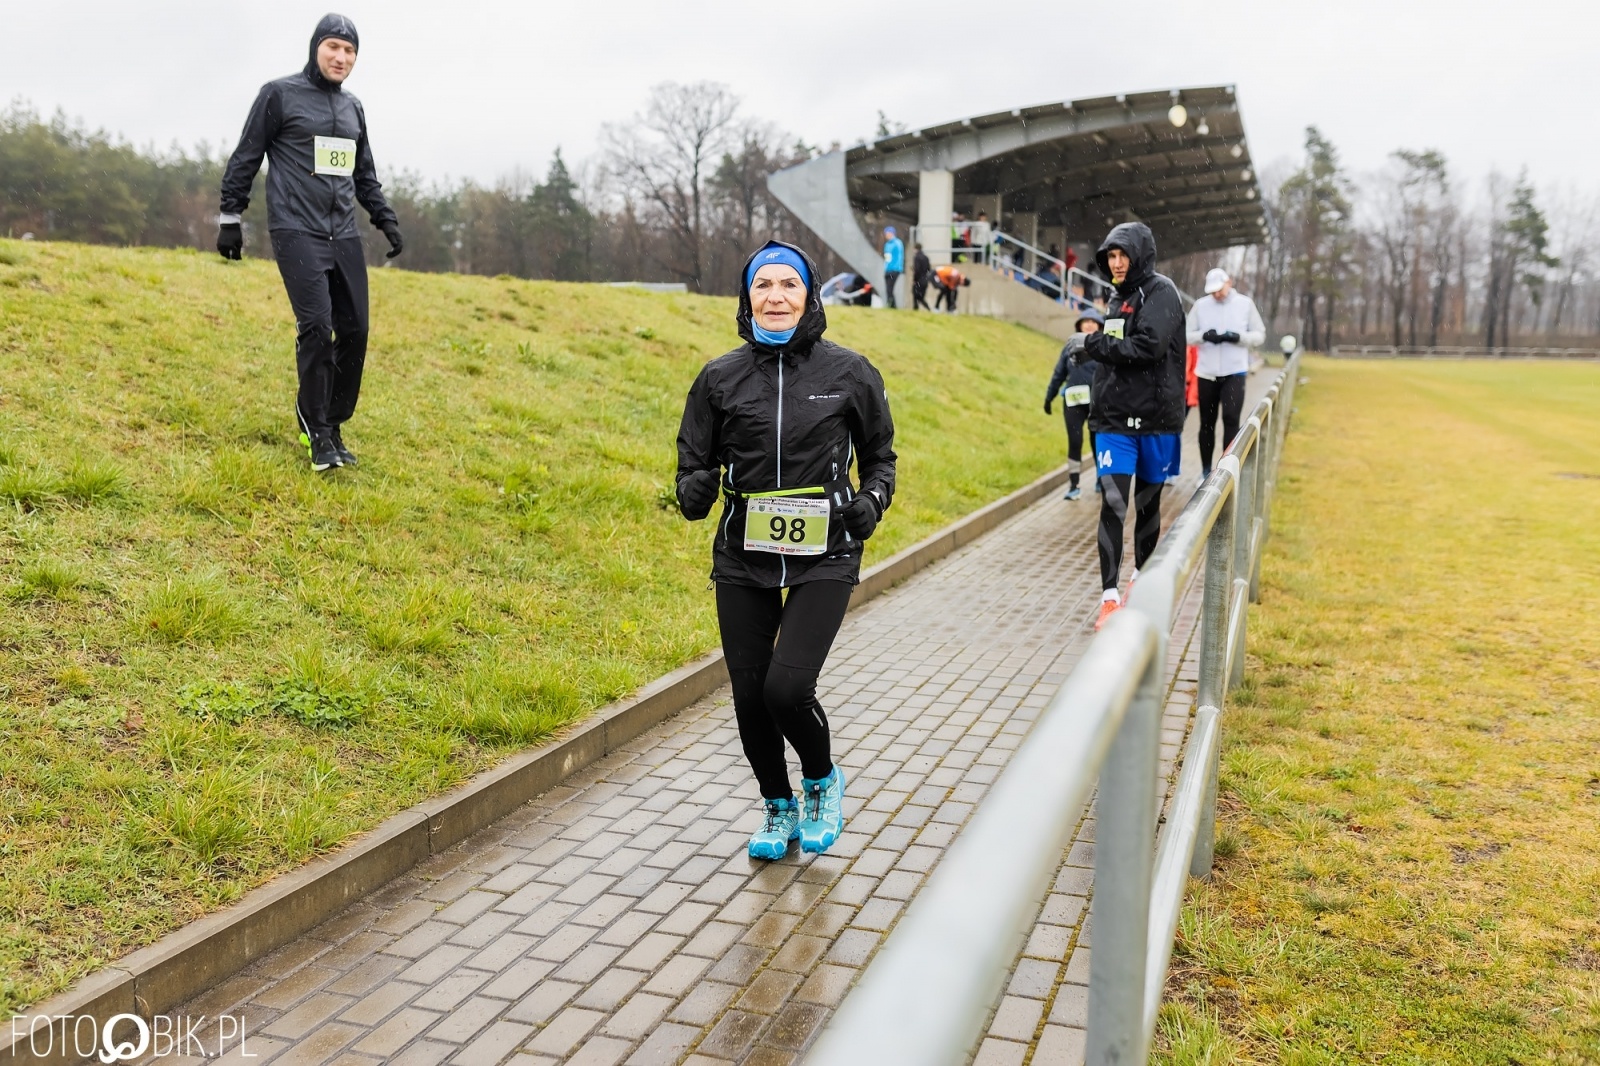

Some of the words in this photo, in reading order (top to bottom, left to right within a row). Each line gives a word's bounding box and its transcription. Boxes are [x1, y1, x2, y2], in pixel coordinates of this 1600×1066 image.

[330, 150, 346, 167] 83
[1097, 449, 1112, 469] 14
[769, 516, 806, 543] 98
